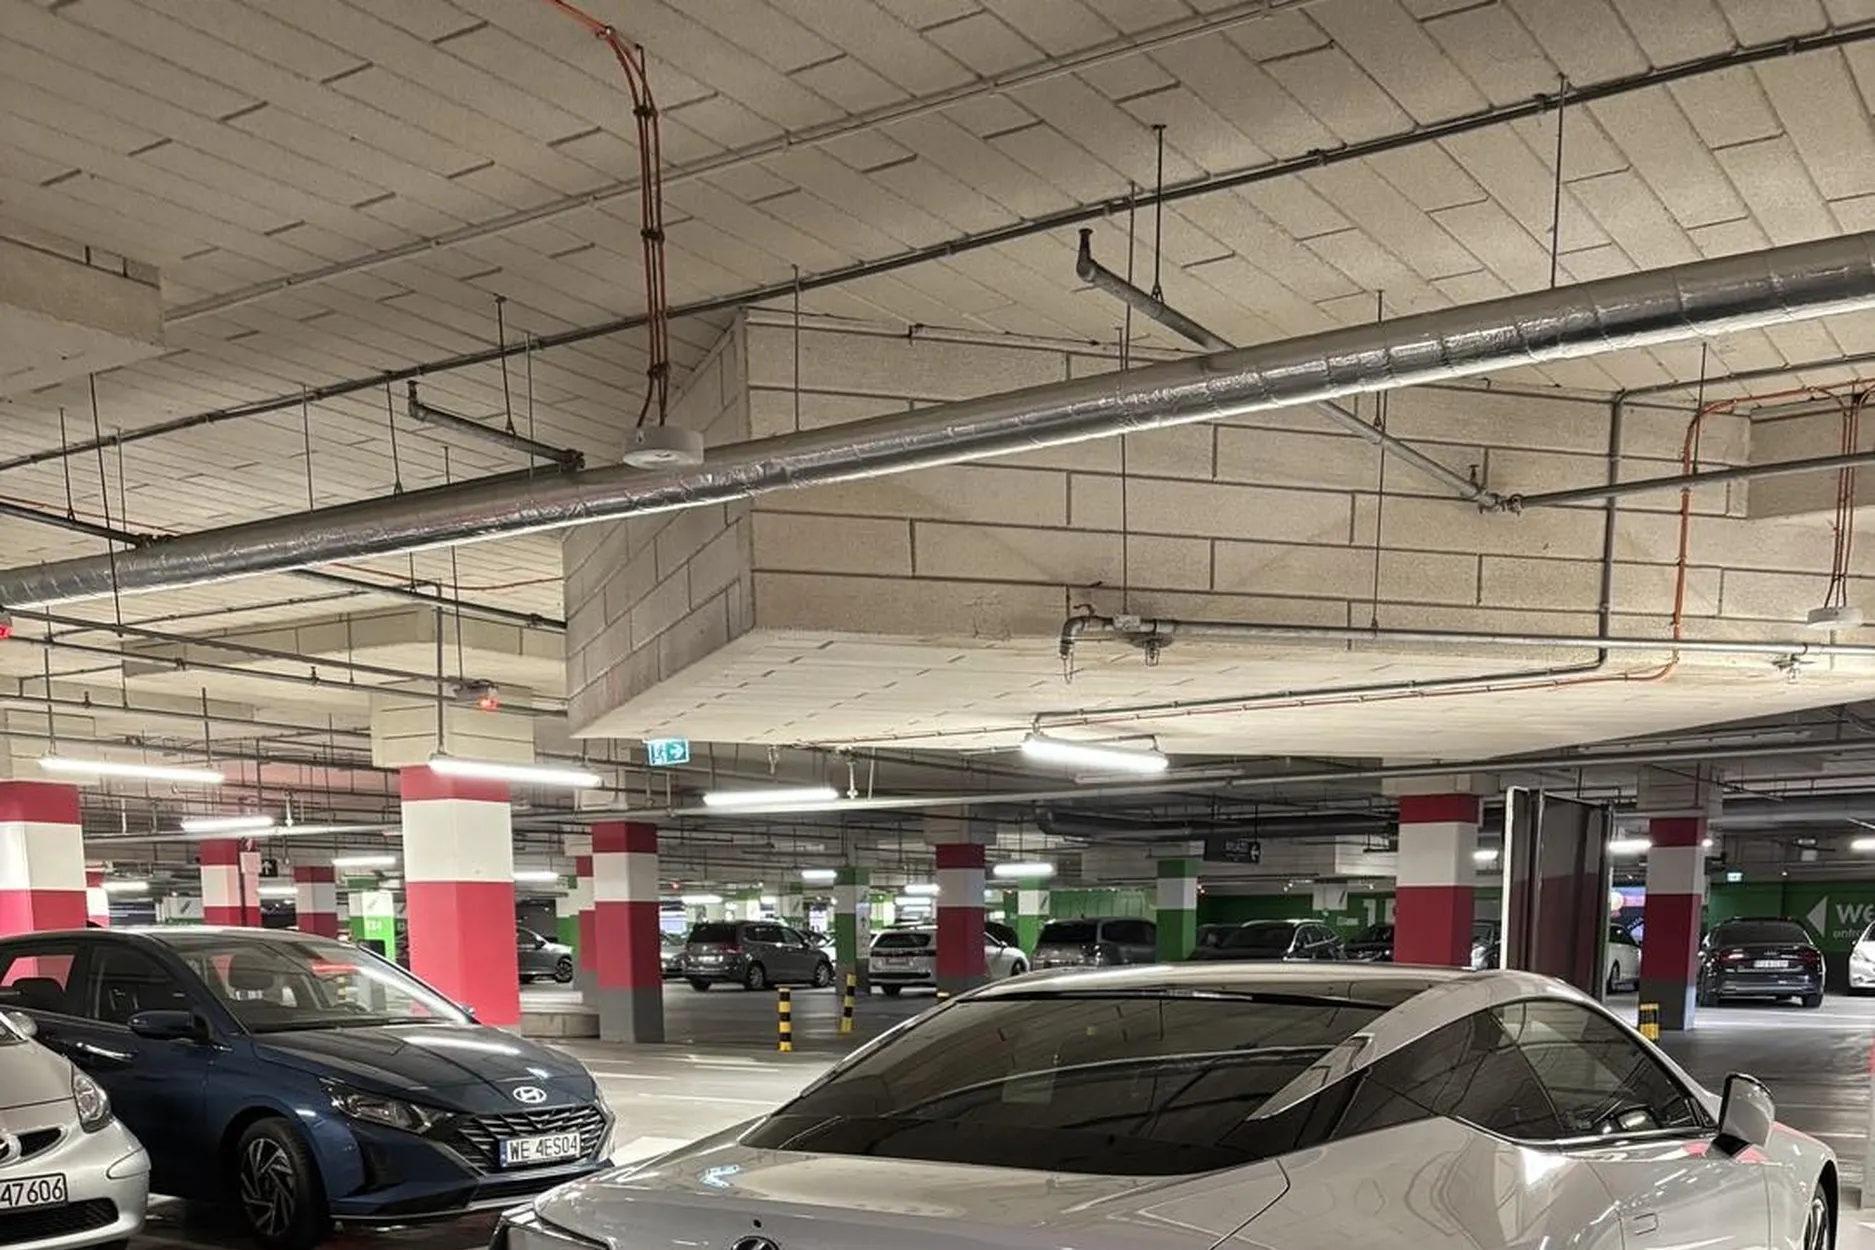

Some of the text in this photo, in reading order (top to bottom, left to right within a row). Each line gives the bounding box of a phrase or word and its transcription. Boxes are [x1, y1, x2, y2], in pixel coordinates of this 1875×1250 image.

[509, 1135, 578, 1160] WE 4ES04
[0, 1178, 63, 1206] 47606
